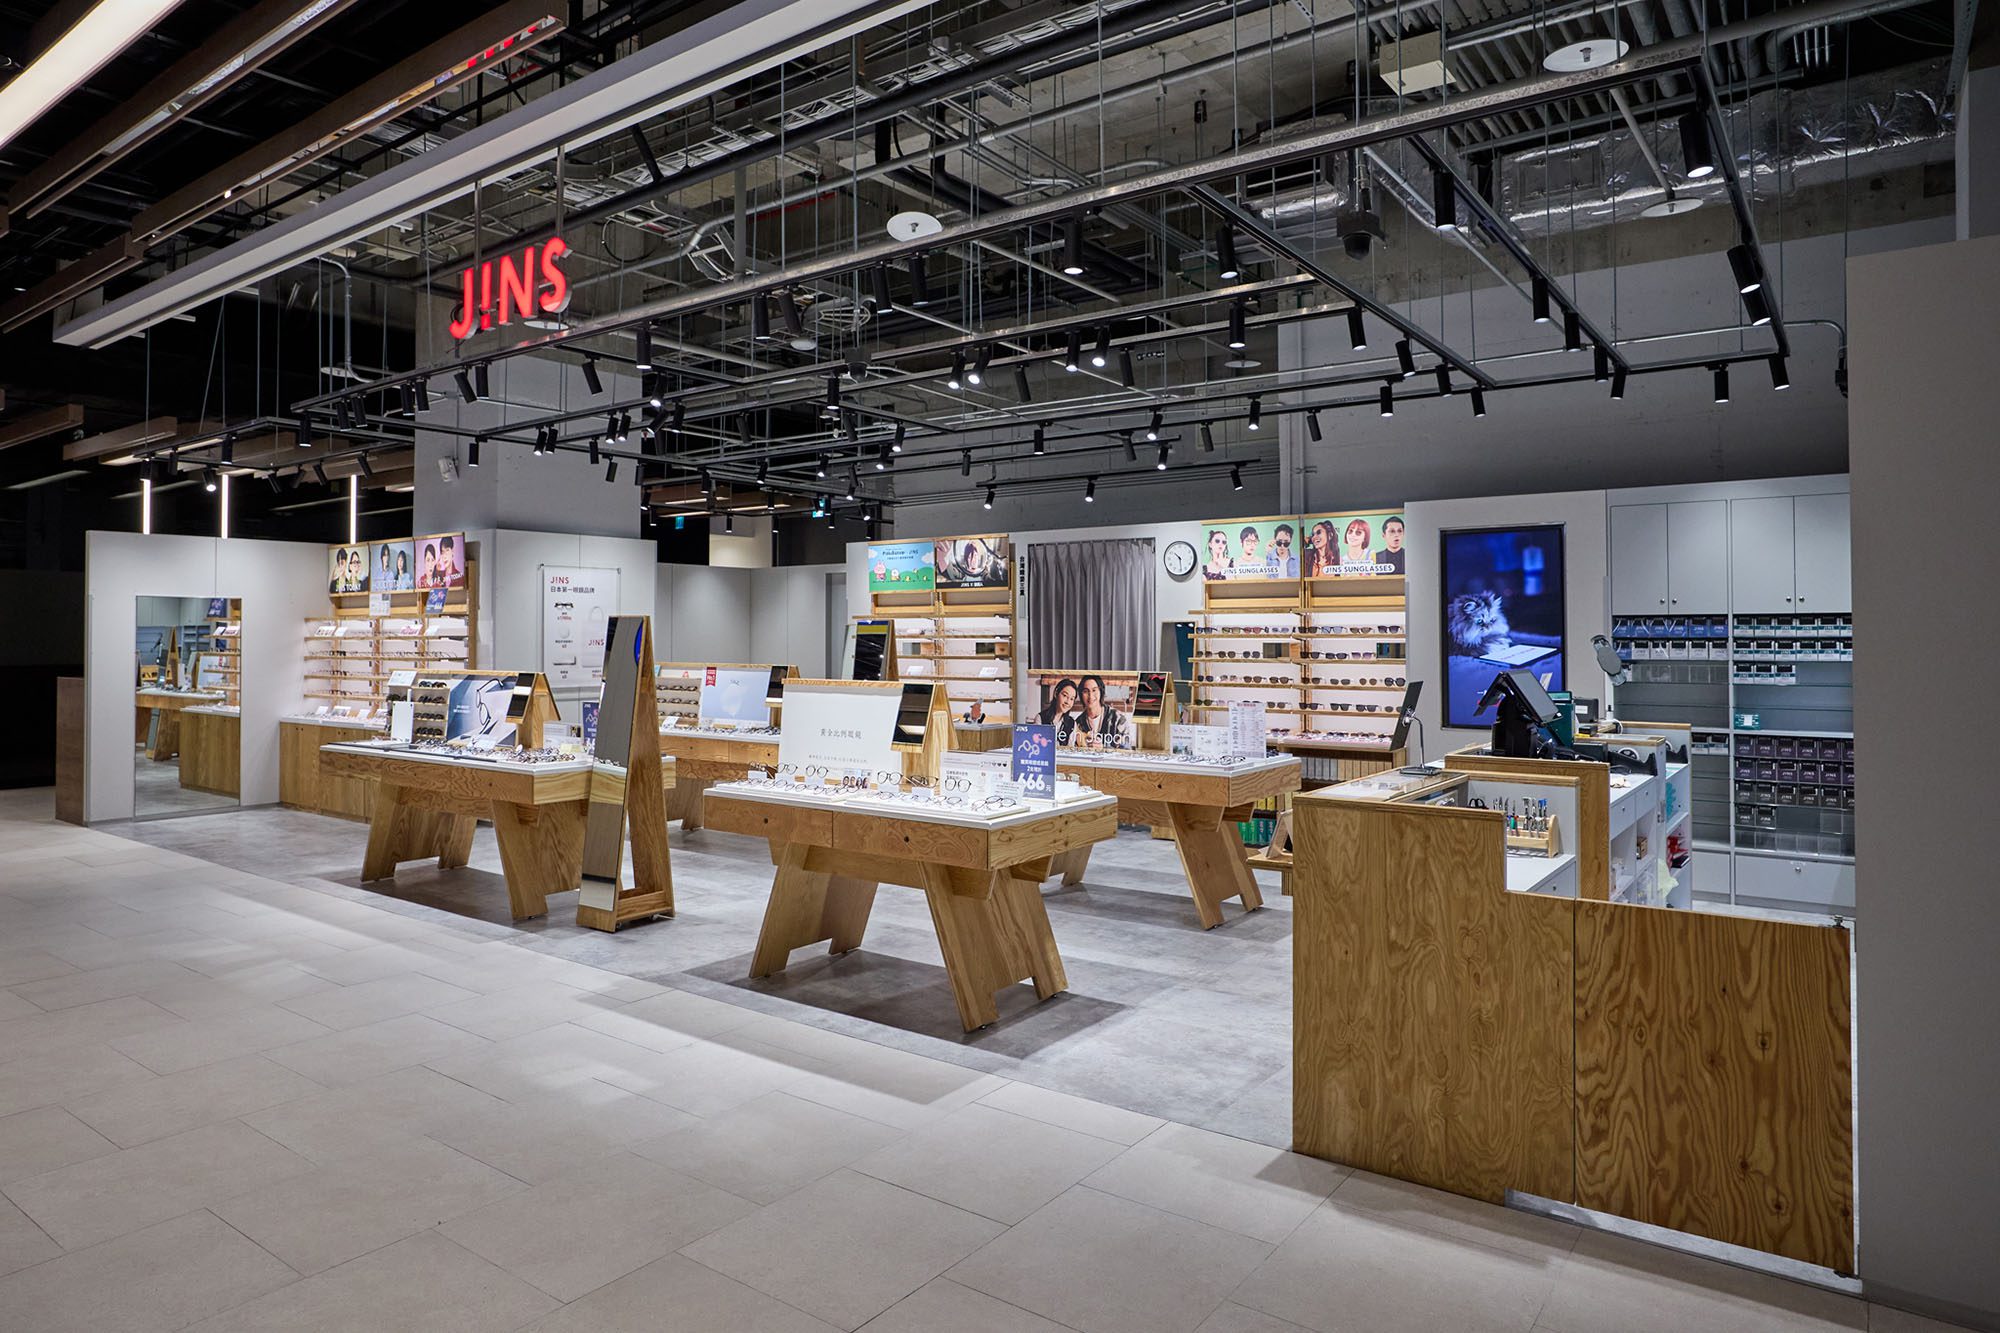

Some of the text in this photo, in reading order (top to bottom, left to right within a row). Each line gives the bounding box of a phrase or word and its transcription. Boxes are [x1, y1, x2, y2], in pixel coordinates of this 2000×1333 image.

[1238, 566, 1279, 574] SUNGLASSES
[1325, 565, 1393, 573] JINS SUNGLASSES
[550, 576, 569, 584] JINS
[1086, 730, 1130, 747] Japan
